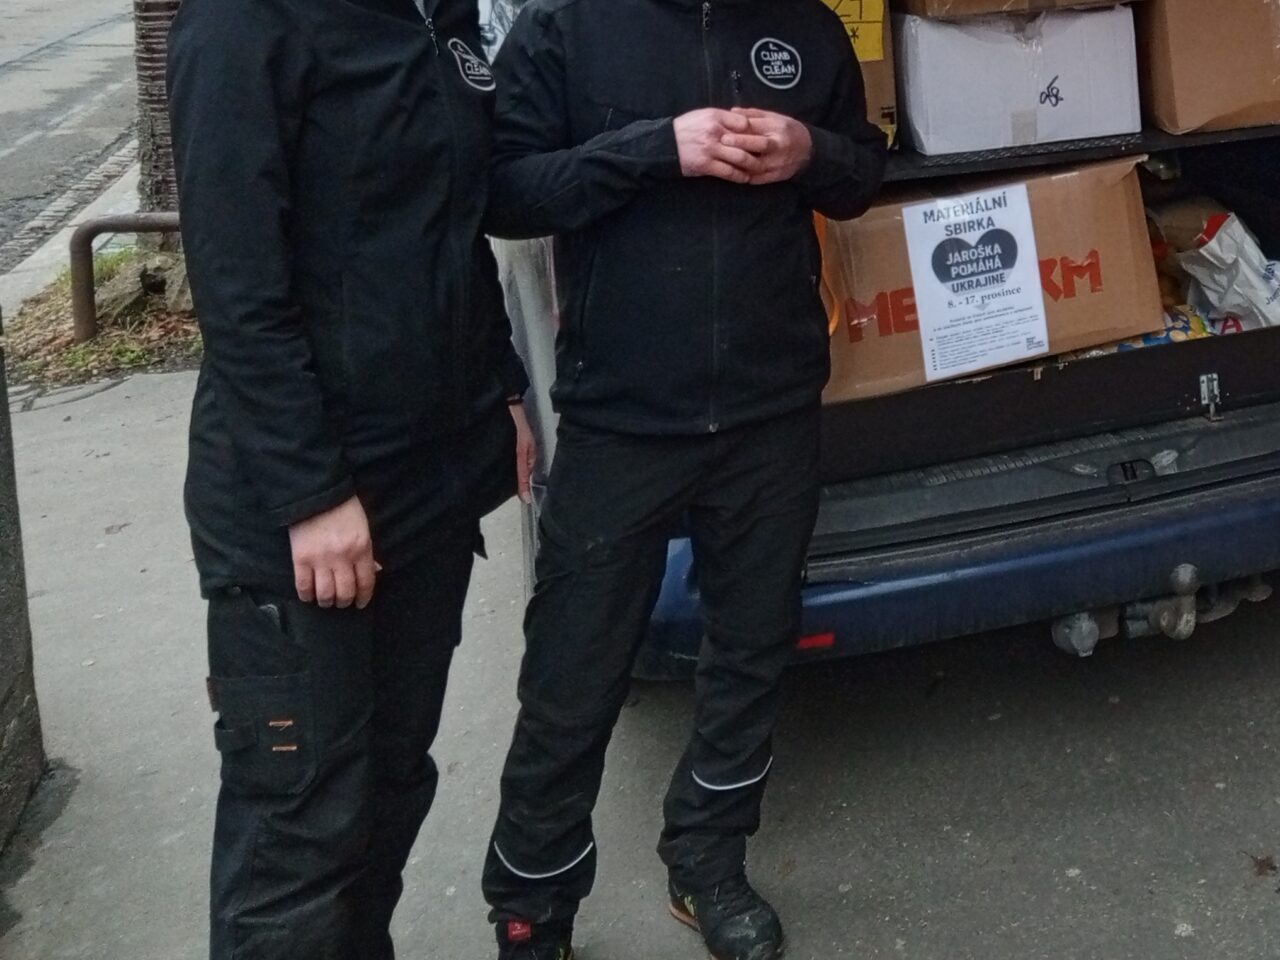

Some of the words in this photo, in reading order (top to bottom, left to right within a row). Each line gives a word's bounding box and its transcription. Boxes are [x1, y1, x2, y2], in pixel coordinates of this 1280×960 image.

[760, 50, 791, 61] CLIMB
[762, 64, 796, 75] CLEAN
[923, 192, 1008, 224] MATERIÁLNÍ
[946, 243, 1002, 265] JAROŠKA
[951, 255, 1003, 279] POMÁHÁ
[965, 295, 979, 305] 17.
[981, 286, 1022, 305] prosince
